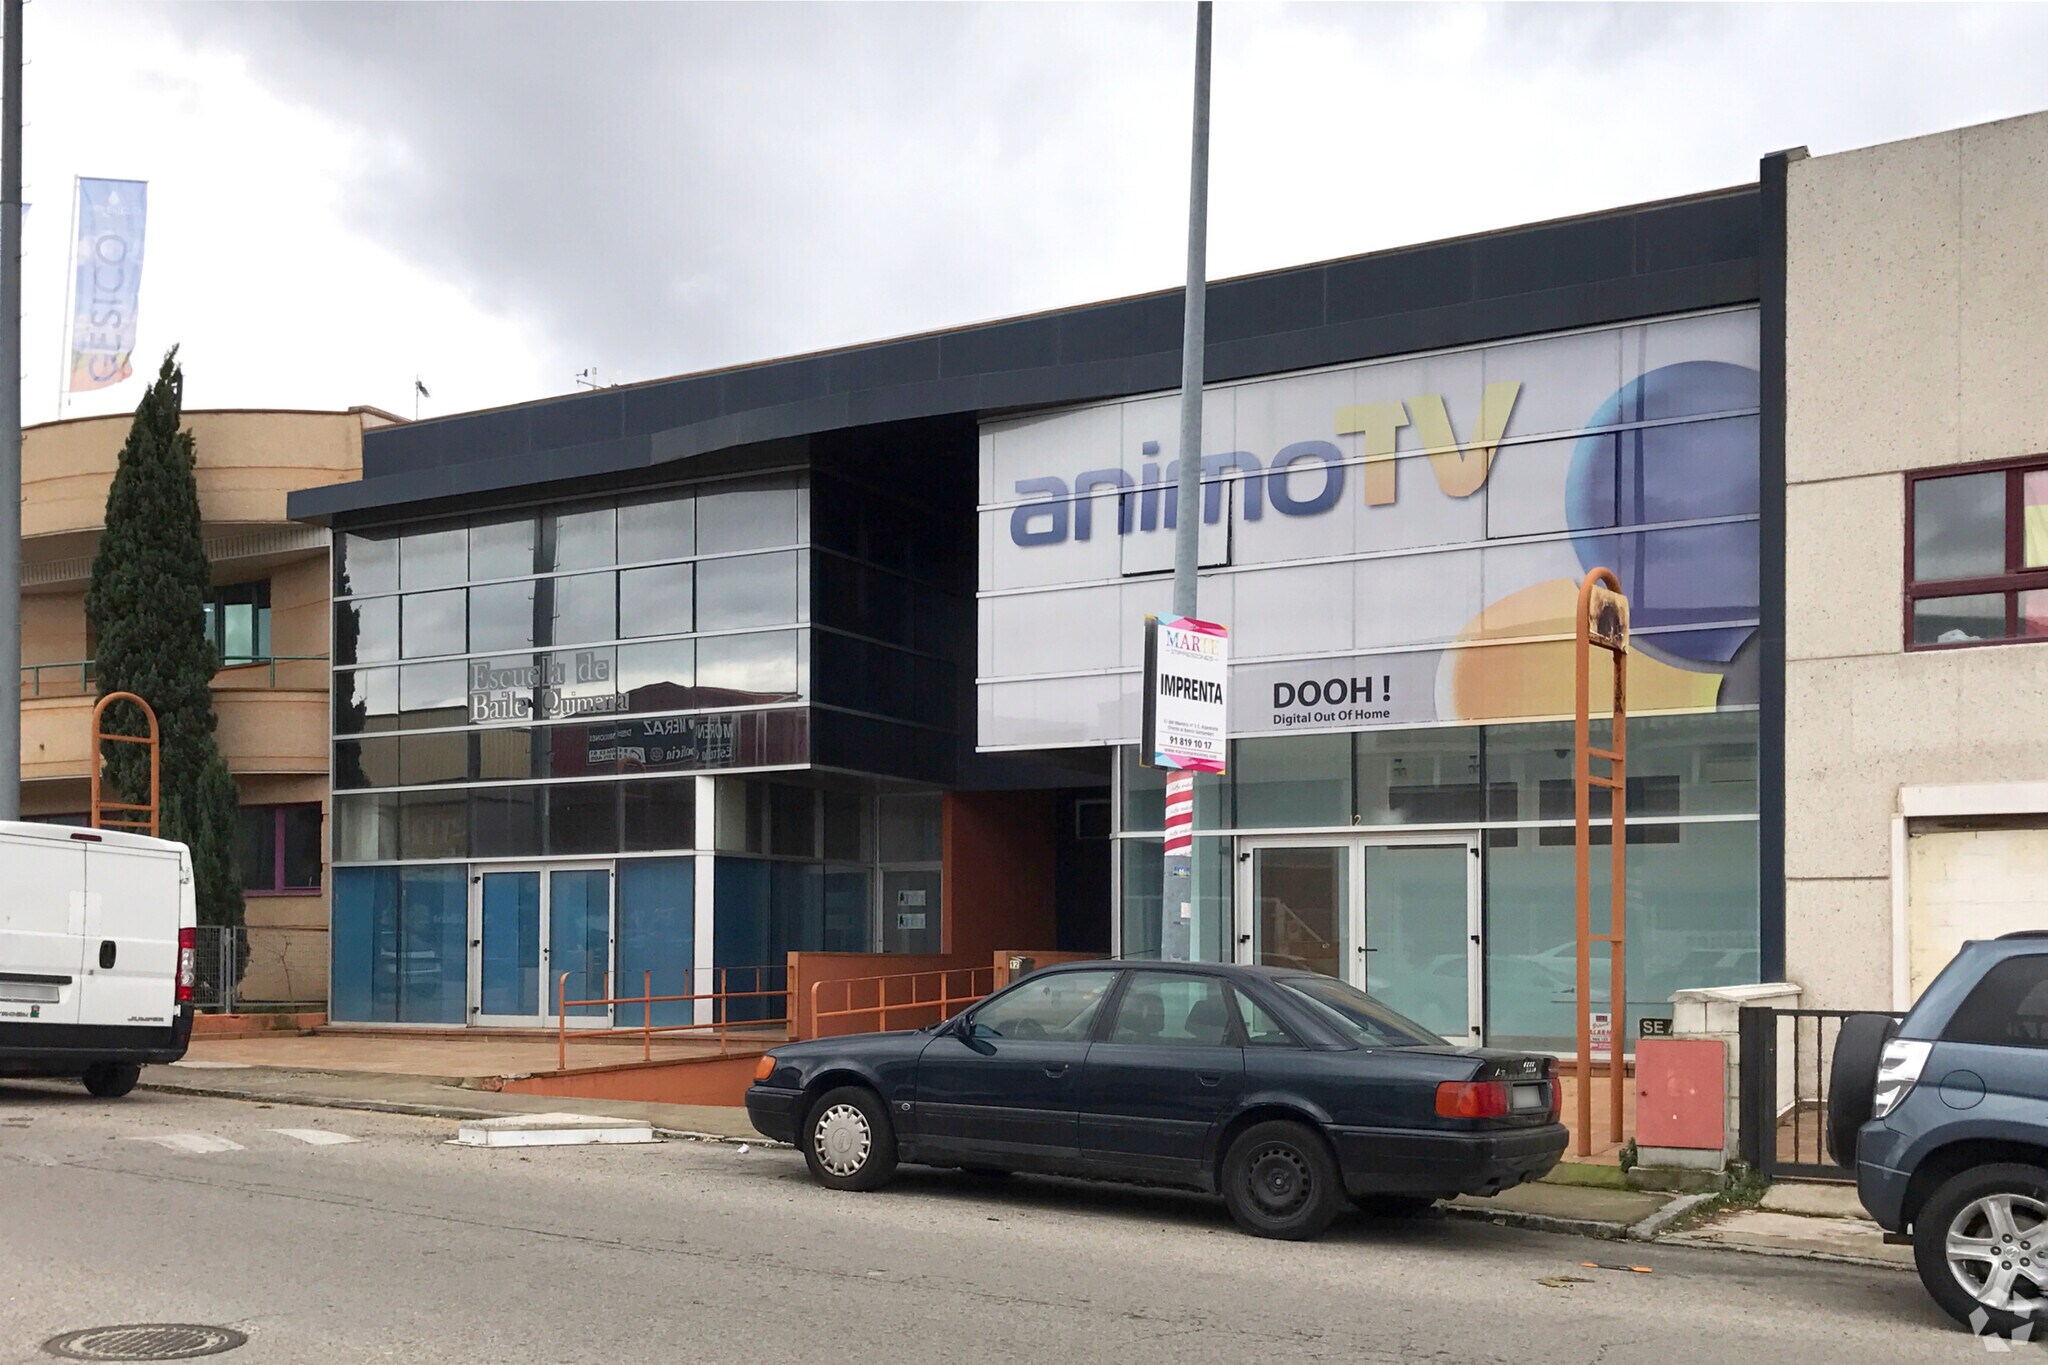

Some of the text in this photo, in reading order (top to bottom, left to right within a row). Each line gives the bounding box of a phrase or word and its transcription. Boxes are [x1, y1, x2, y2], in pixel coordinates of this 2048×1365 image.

[87, 234, 127, 382] GESICO
[1166, 630, 1220, 656] MARTE
[471, 652, 608, 691] Escuela de
[470, 689, 629, 721] Baile Quimera
[1160, 673, 1223, 705] IMPRENTA
[1273, 676, 1373, 709] DOOH
[1273, 708, 1390, 727] Digital Out Of Home
[1169, 735, 1212, 750] 91 819 10 17
[1642, 1020, 1665, 1034] SE
